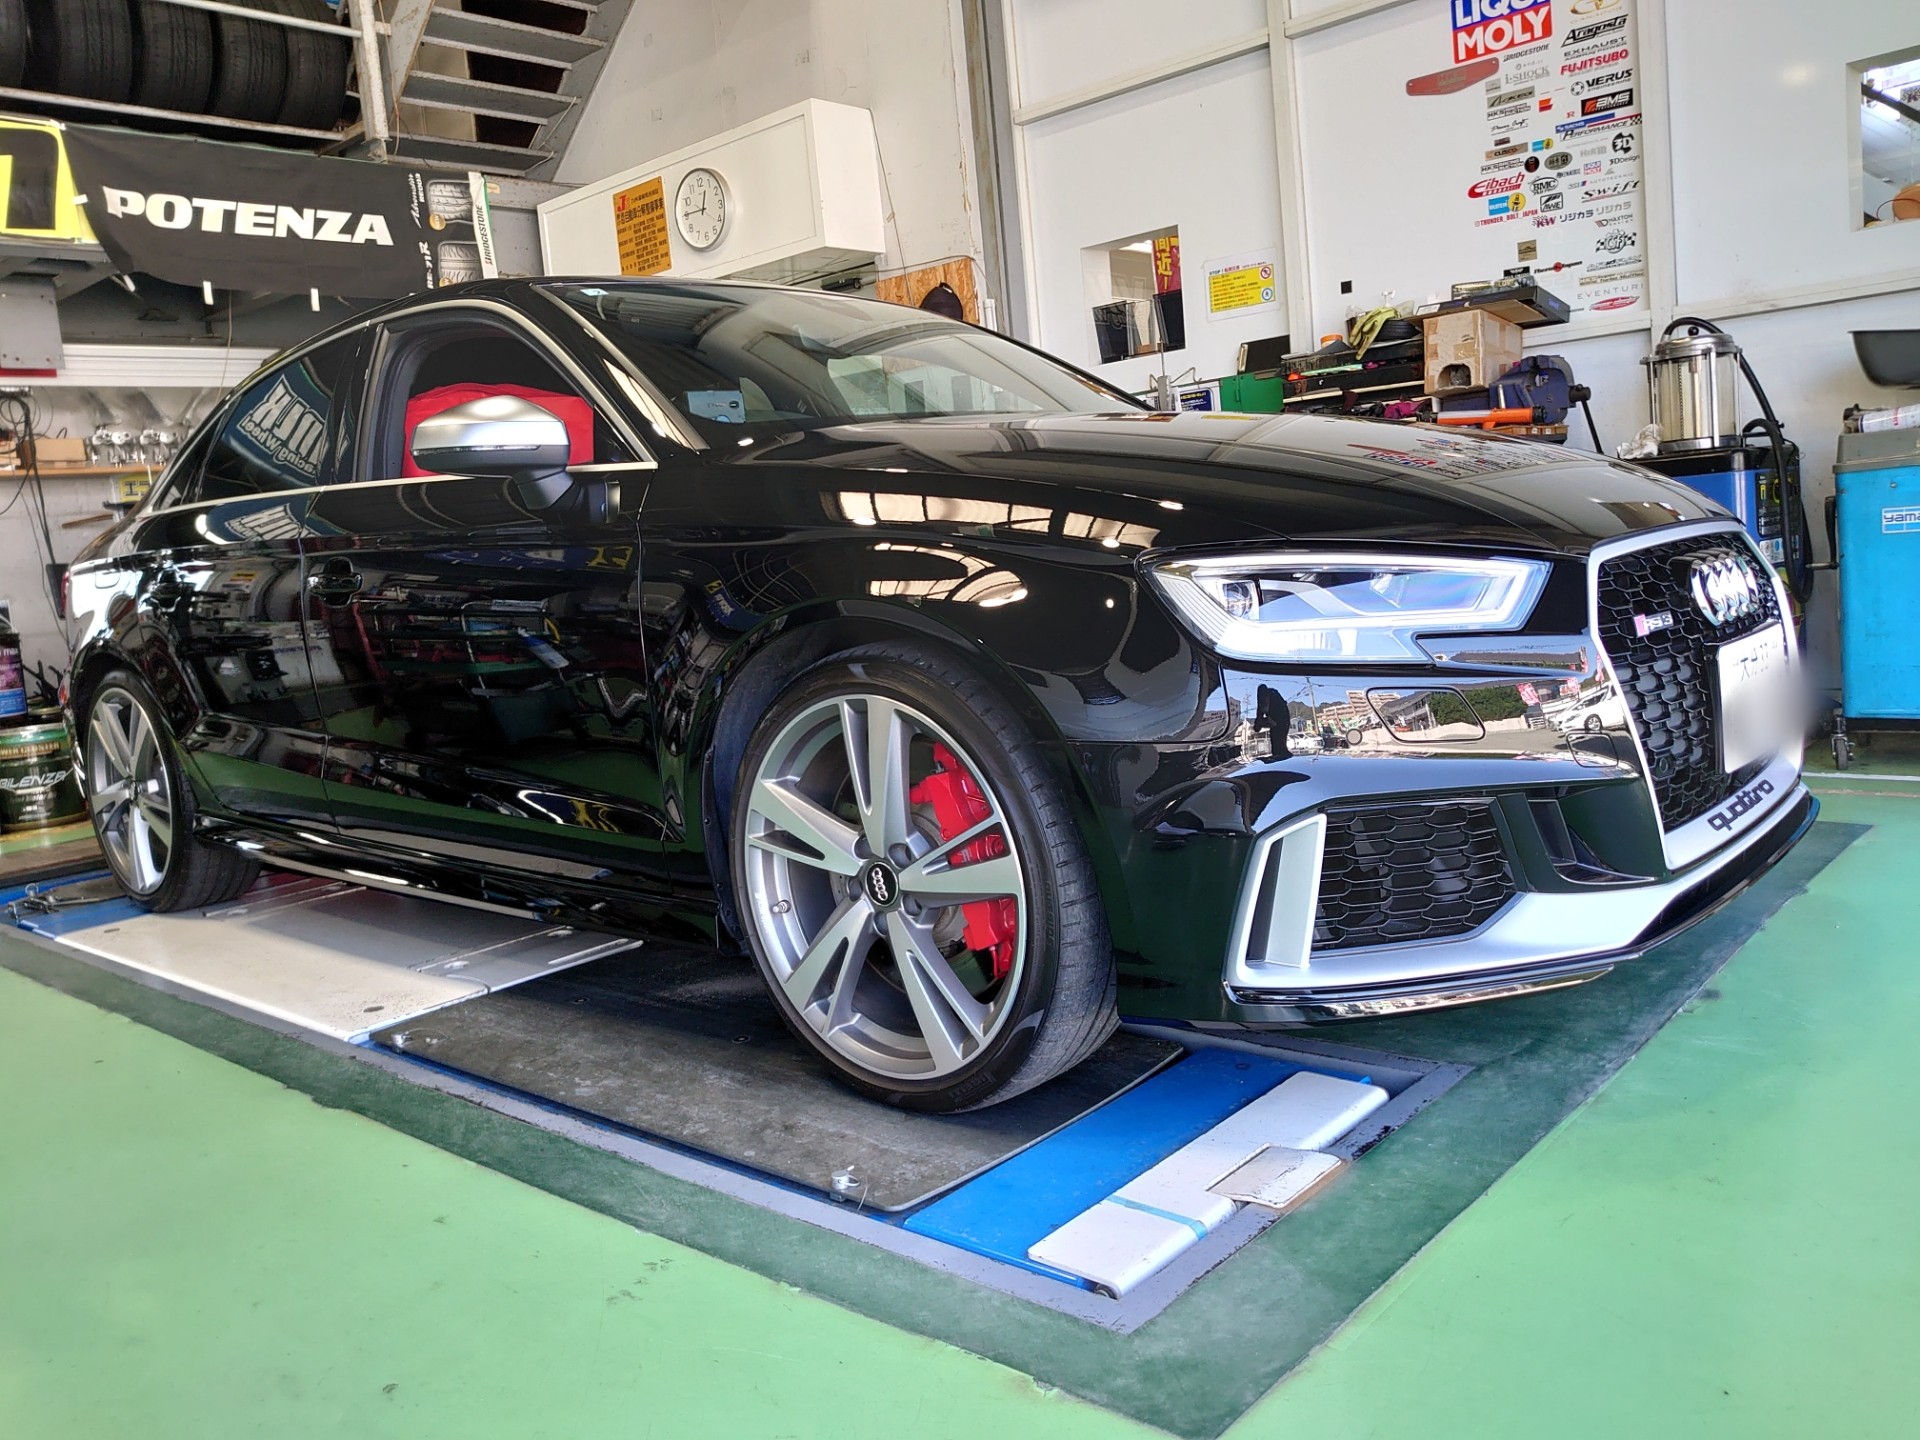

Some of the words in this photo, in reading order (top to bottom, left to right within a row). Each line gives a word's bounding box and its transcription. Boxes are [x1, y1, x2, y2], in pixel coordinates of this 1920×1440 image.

[1456, 0, 1546, 28] LIQ
[1457, 6, 1550, 60] MOLY
[1561, 14, 1629, 48] Aragosta
[1503, 44, 1550, 62] BRIDGESTONE
[1564, 36, 1628, 57] EXHAUST
[1560, 48, 1629, 75] FUJITSUBO
[1585, 68, 1633, 88] VERUS
[1563, 120, 1629, 140] PERFORMANCE
[696, 177, 704, 188] 12
[713, 186, 719, 196] 2
[1468, 171, 1525, 198] Eibach
[1533, 180, 1556, 191] BMC
[682, 196, 691, 206] 10
[717, 199, 723, 209] 3
[1543, 201, 1561, 211] AWE
[102, 186, 394, 246] POTENZA
[717, 214, 722, 223] 4
[1560, 209, 1594, 223] リジカラ
[1596, 201, 1631, 215] リジカラ
[475, 204, 494, 266] BRIDGESTONE
[688, 223, 694, 233] 8
[696, 231, 701, 240] 7
[704, 231, 710, 241] 6
[712, 225, 718, 235] 5
[418, 241, 434, 290] RE-71R
[1577, 283, 1644, 299] EVENTURI
[1707, 779, 1775, 832] quattro
